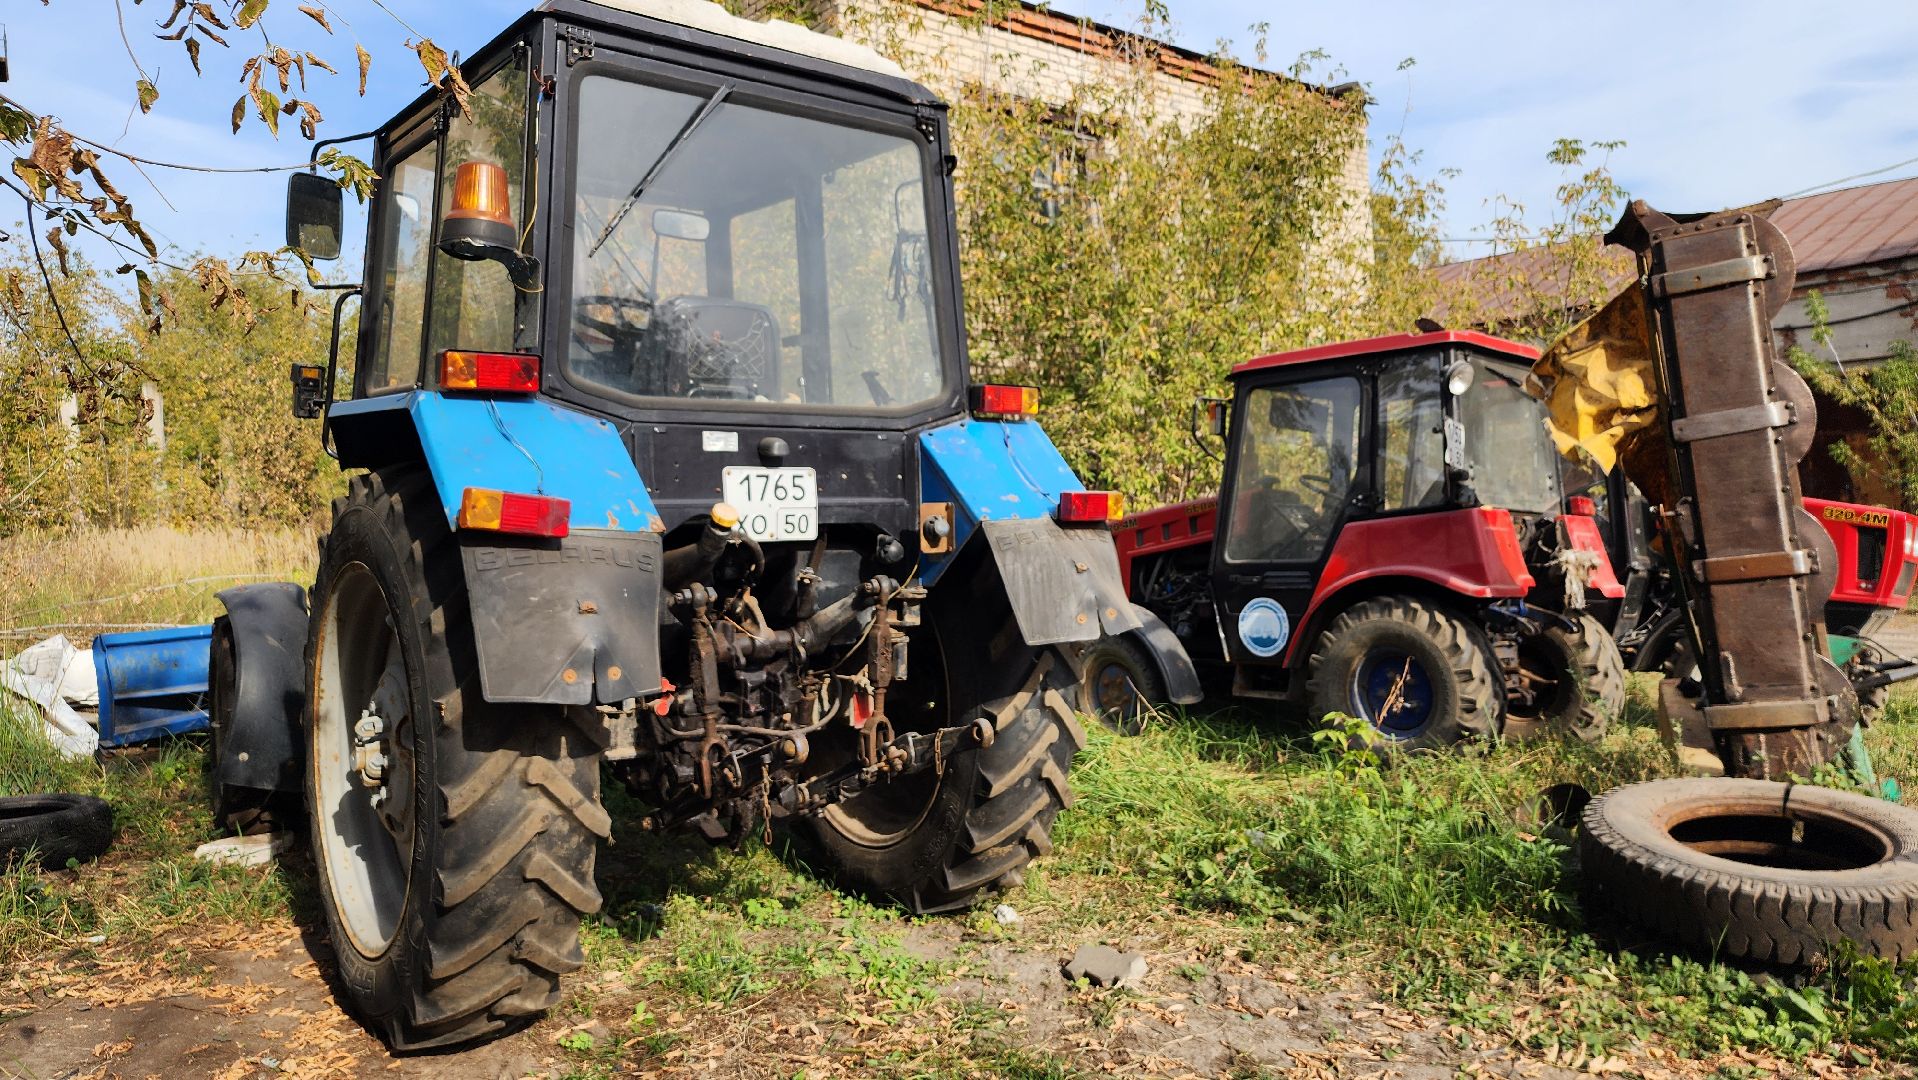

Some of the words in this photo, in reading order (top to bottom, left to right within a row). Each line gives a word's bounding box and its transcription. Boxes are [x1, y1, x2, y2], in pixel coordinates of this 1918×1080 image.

[739, 474, 805, 502] 1765
[784, 514, 809, 534] 50
[474, 544, 656, 574] BELARUS
